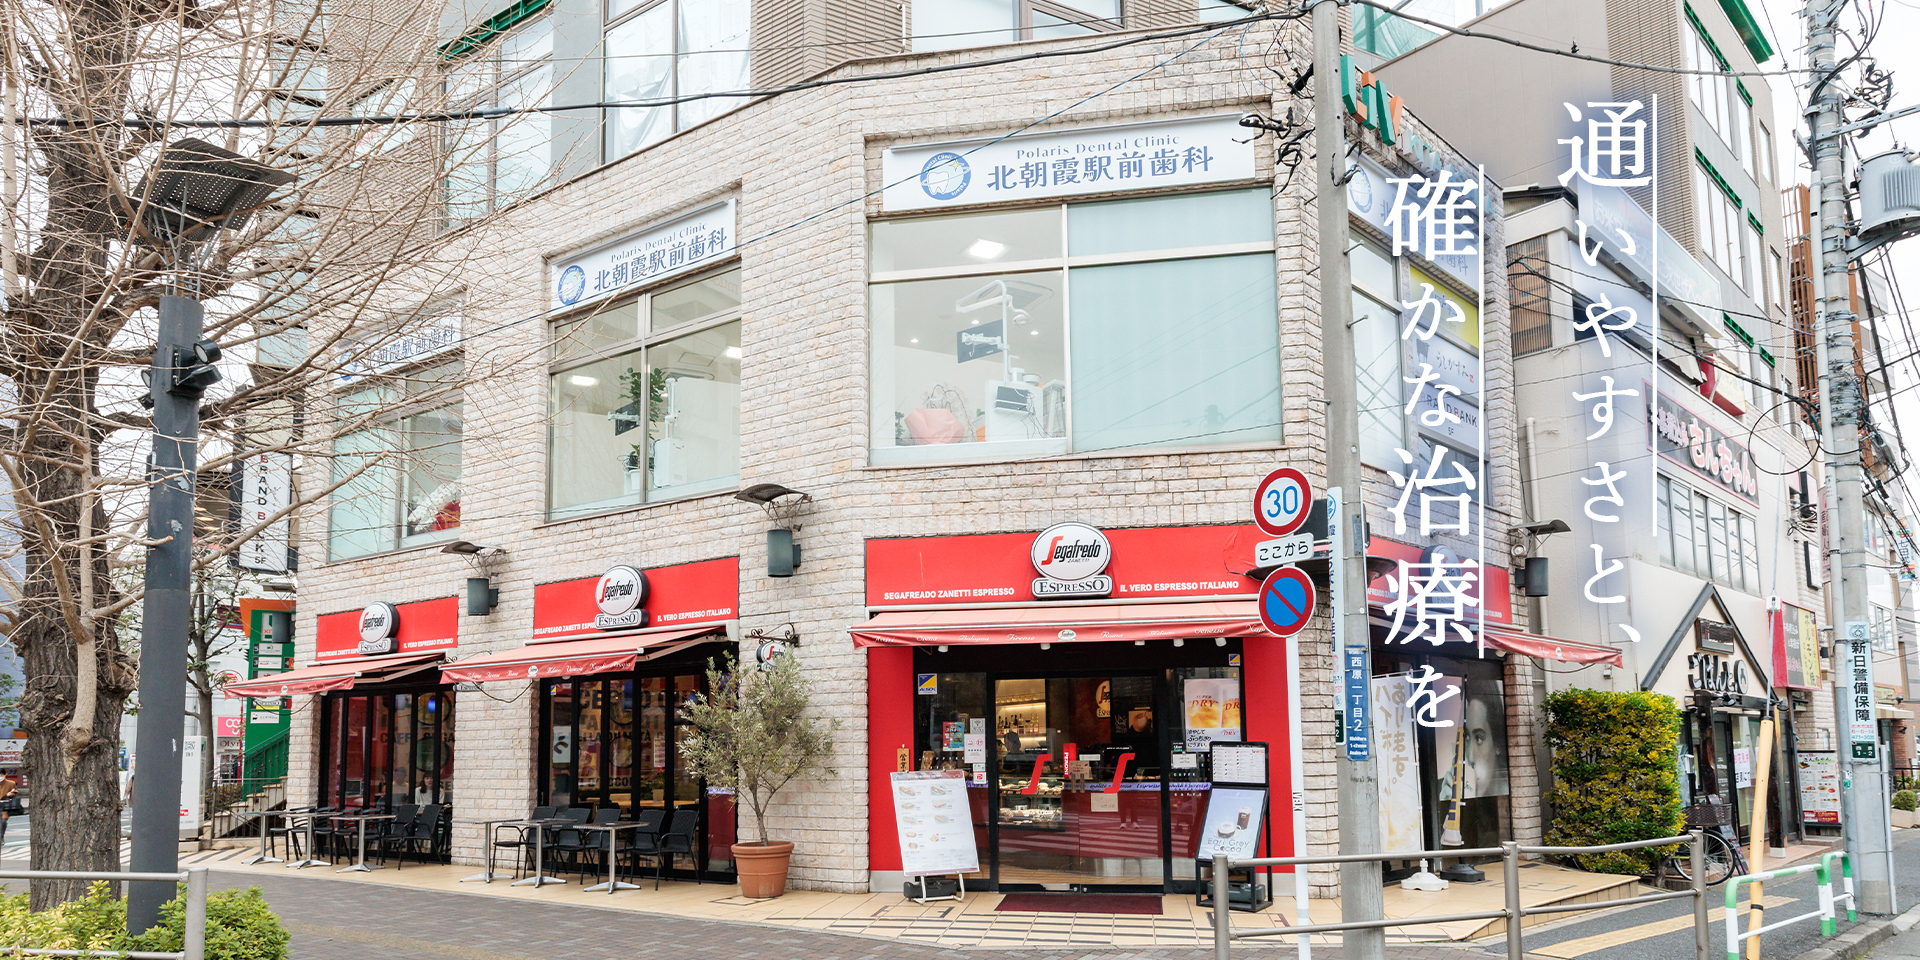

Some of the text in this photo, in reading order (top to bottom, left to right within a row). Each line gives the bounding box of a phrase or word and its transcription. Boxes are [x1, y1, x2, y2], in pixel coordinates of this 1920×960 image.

[1017, 135, 1180, 159] Polaris Dental Clinic
[987, 146, 1213, 191] 北朝霞駅前歯科
[611, 223, 707, 263] Polaris Dental Clinic
[594, 227, 727, 292] 北朝霞駅前歯科
[1453, 406, 1477, 428] BANK
[1688, 417, 1756, 496] さんちゃん
[1267, 486, 1298, 518] 30
[1041, 535, 1101, 566] Segafredo
[1260, 541, 1308, 561] ここから
[599, 578, 634, 604] Segafredo
[884, 587, 1015, 600] SEGAFREADO ZANETTI ESPRESSO
[1039, 578, 1104, 593] ESPRESSO
[1120, 581, 1239, 592] IL VERO ESPRESSO ITALIANO
[598, 613, 636, 626] ESPRESSO
[663, 613, 678, 621] VERO
[678, 611, 706, 620] ESPRESSO
[706, 608, 731, 617] ITALIANO
[534, 625, 562, 635] SEGAFREADO
[1851, 641, 1870, 722] 新日警備保障
[1228, 839, 1250, 847] Grey
